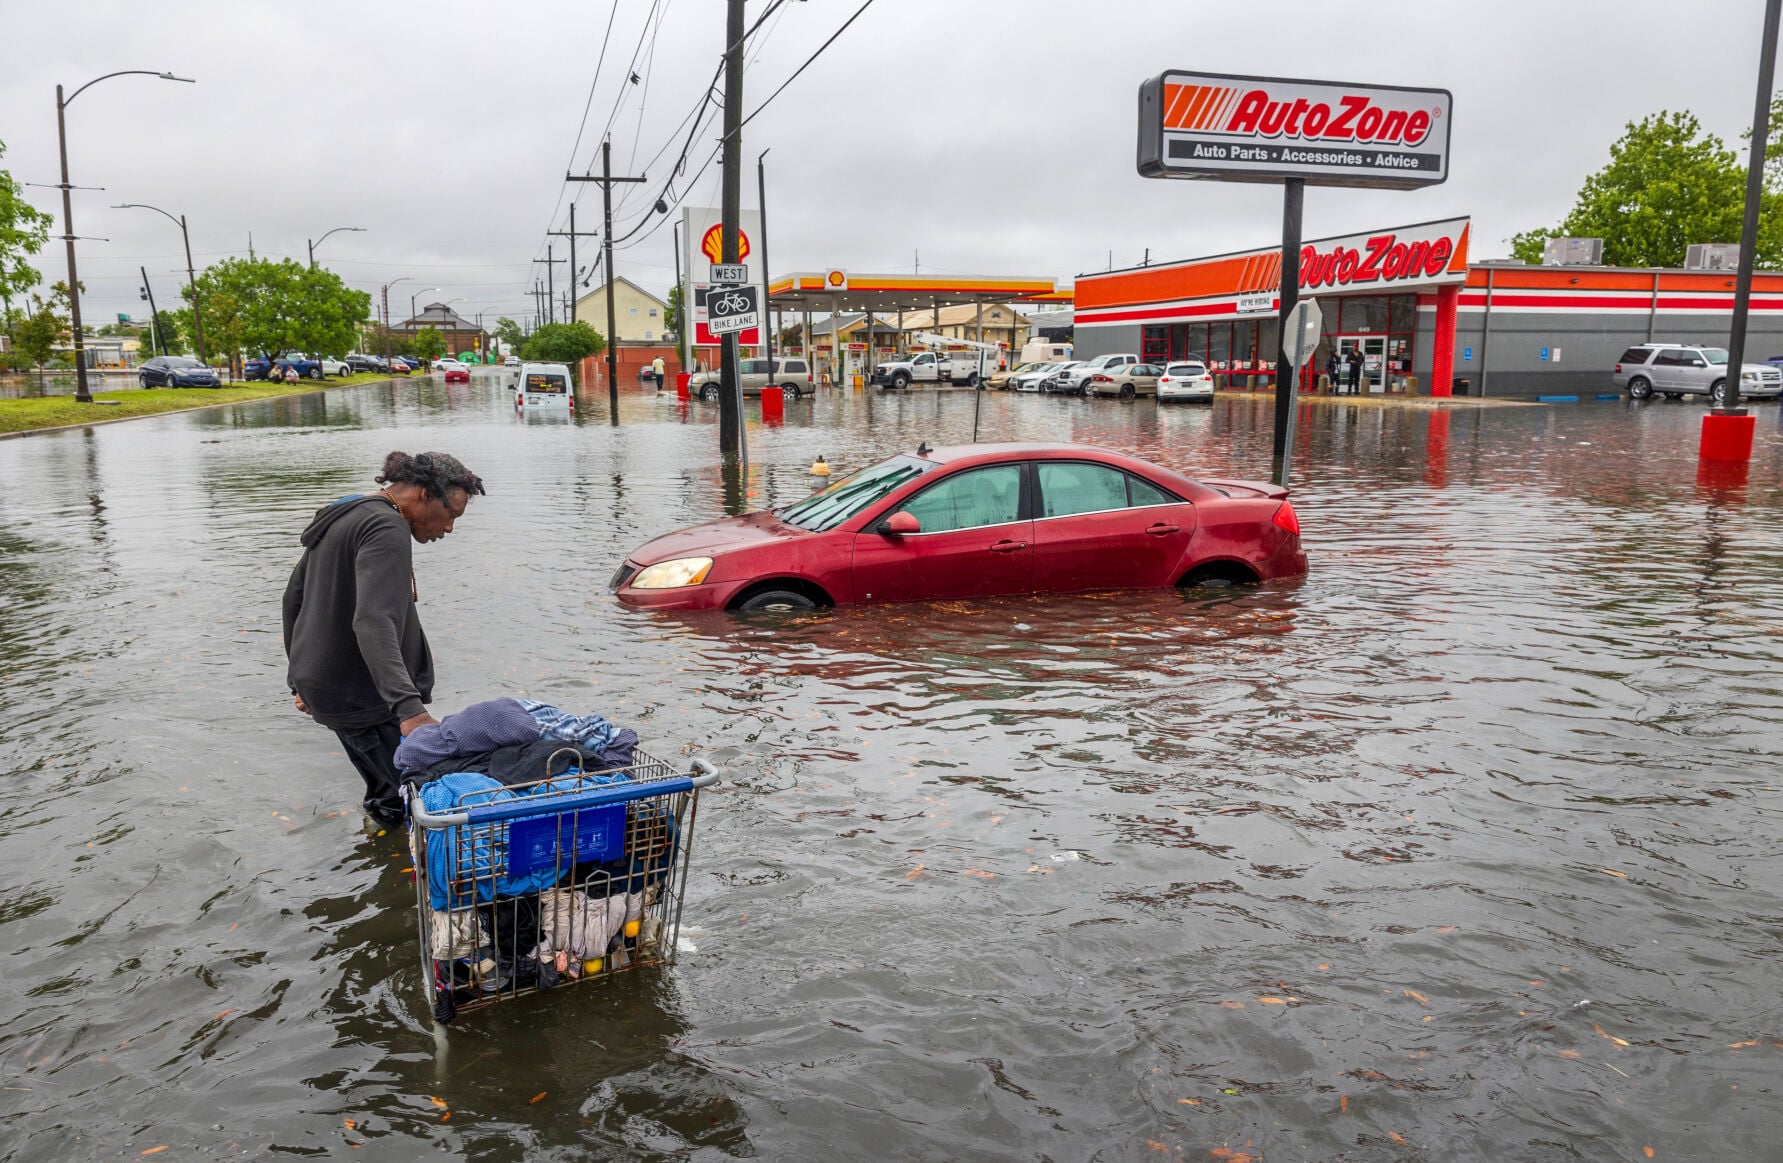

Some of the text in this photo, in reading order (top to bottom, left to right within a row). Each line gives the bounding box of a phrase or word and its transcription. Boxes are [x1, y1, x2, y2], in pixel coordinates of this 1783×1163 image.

[1226, 90, 1431, 146] AutoZone
[1193, 143, 1418, 168] Auto Parts Accessories Advice
[715, 268, 743, 280] WEST
[714, 315, 753, 330] BIKE LANE
